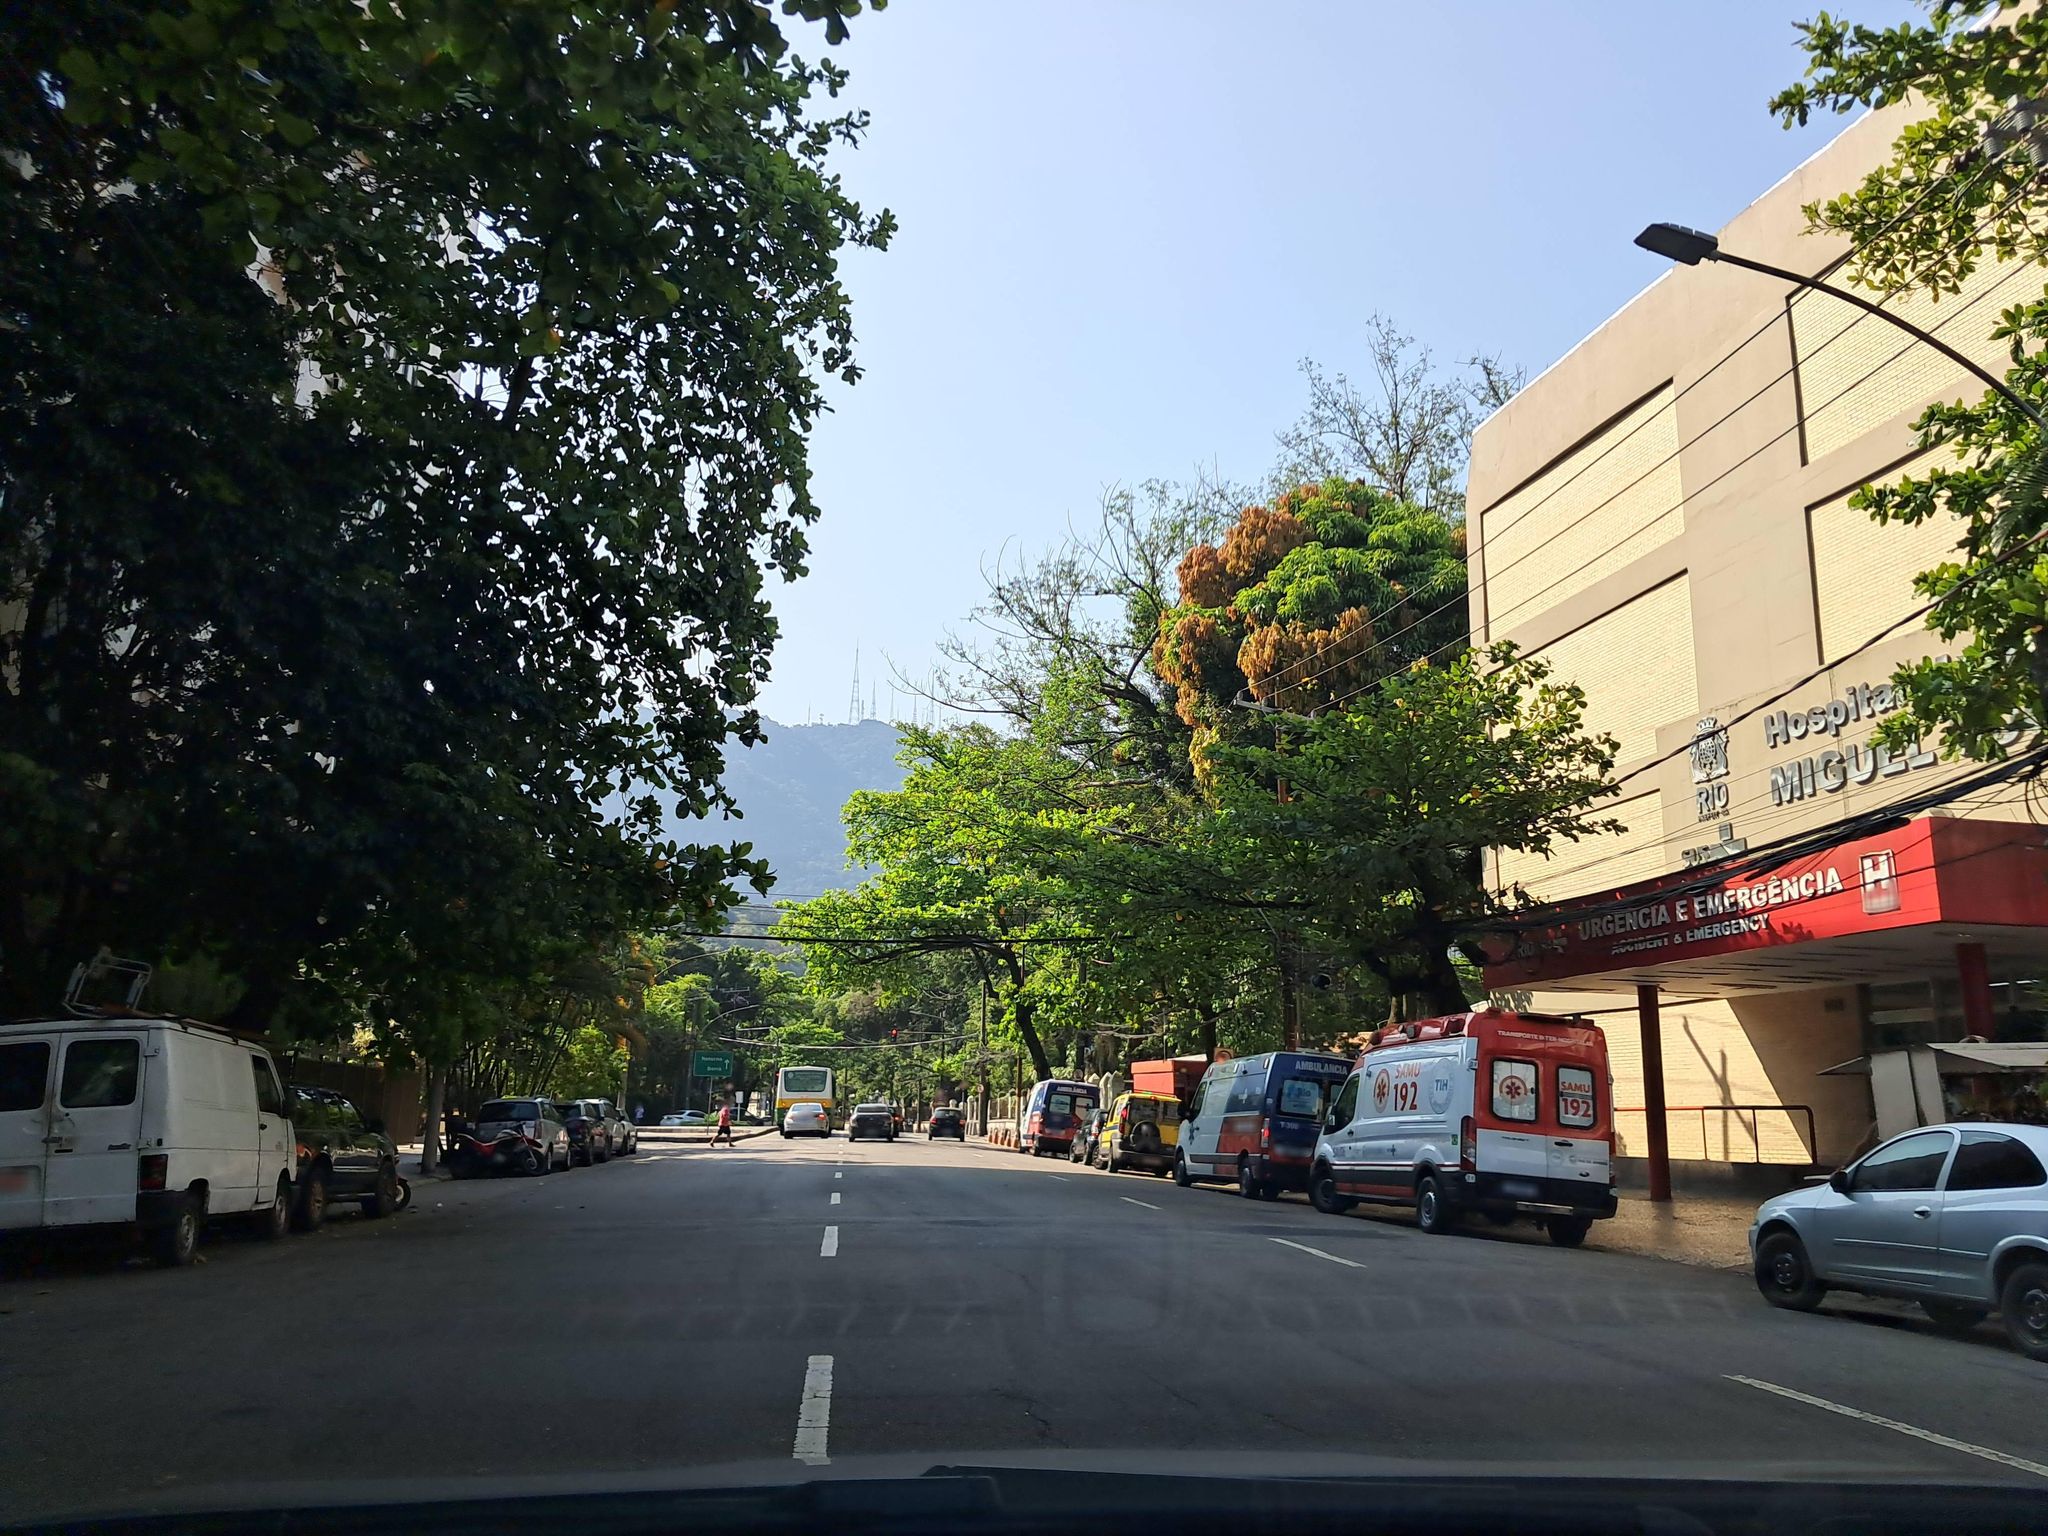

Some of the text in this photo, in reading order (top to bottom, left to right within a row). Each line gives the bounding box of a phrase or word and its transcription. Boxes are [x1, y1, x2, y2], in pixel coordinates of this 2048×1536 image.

[1770, 733, 1938, 806] MIGUEL
[1696, 782, 1729, 815] RIO
[1675, 900, 1688, 922] E
[1693, 867, 1844, 918] EMERGÊNCIA
[1686, 914, 1769, 942] EMERGENCY
[1395, 1062, 1420, 1079] SAMU
[1393, 1081, 1418, 1111] 192
[1435, 1079, 1449, 1091] TIH
[1561, 1081, 1591, 1093] SAMU
[1561, 1097, 1592, 1118] 192
